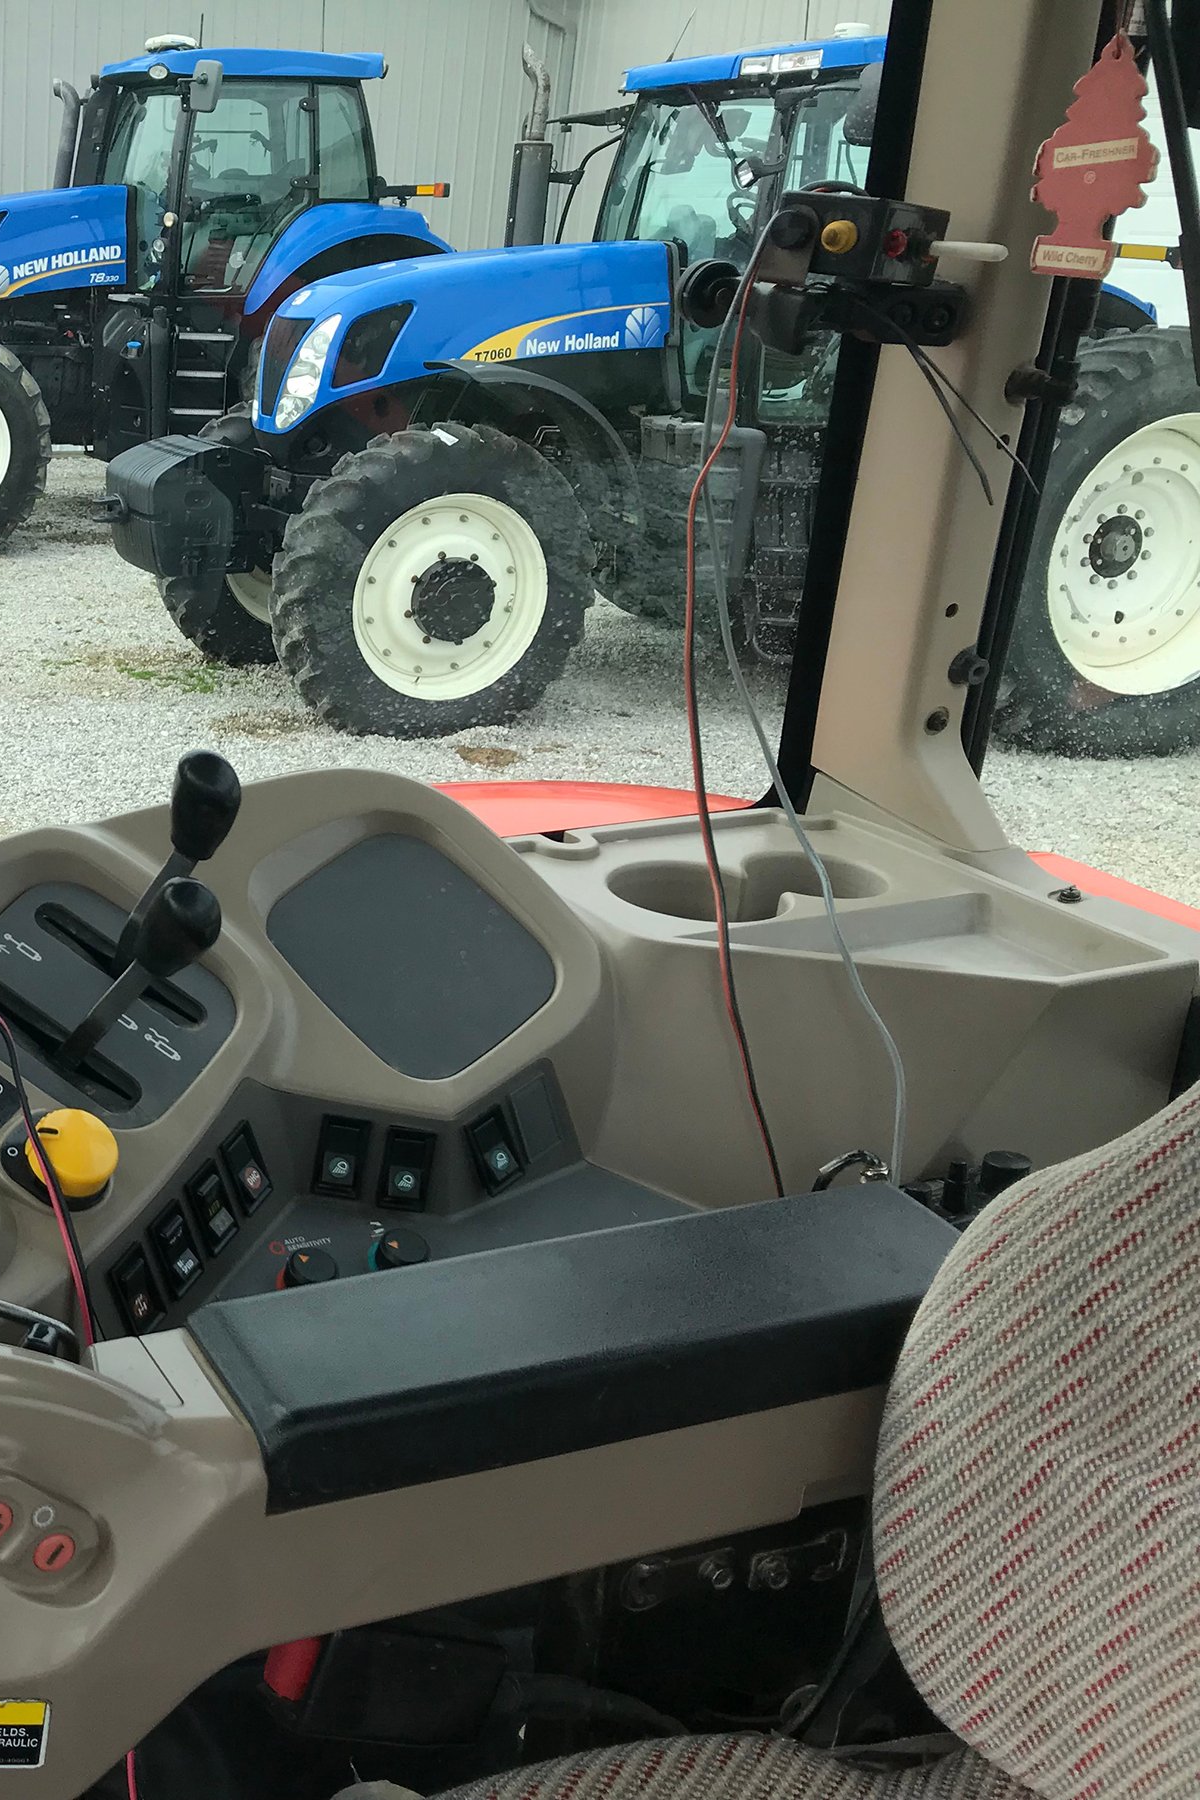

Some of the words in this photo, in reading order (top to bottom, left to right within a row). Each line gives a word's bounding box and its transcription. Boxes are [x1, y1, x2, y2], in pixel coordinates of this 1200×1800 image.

[1056, 145, 1135, 163] CAR-FRESHNER
[13, 257, 48, 280] NEW
[51, 245, 121, 269] HOLLAND
[1042, 250, 1063, 262] Wild
[1065, 252, 1099, 267] Cherry
[526, 337, 560, 356] New
[564, 331, 620, 351] Holland
[475, 347, 512, 361] T7060
[284, 1235, 305, 1245] AUTO
[287, 1237, 332, 1251] SENSITIVITY
